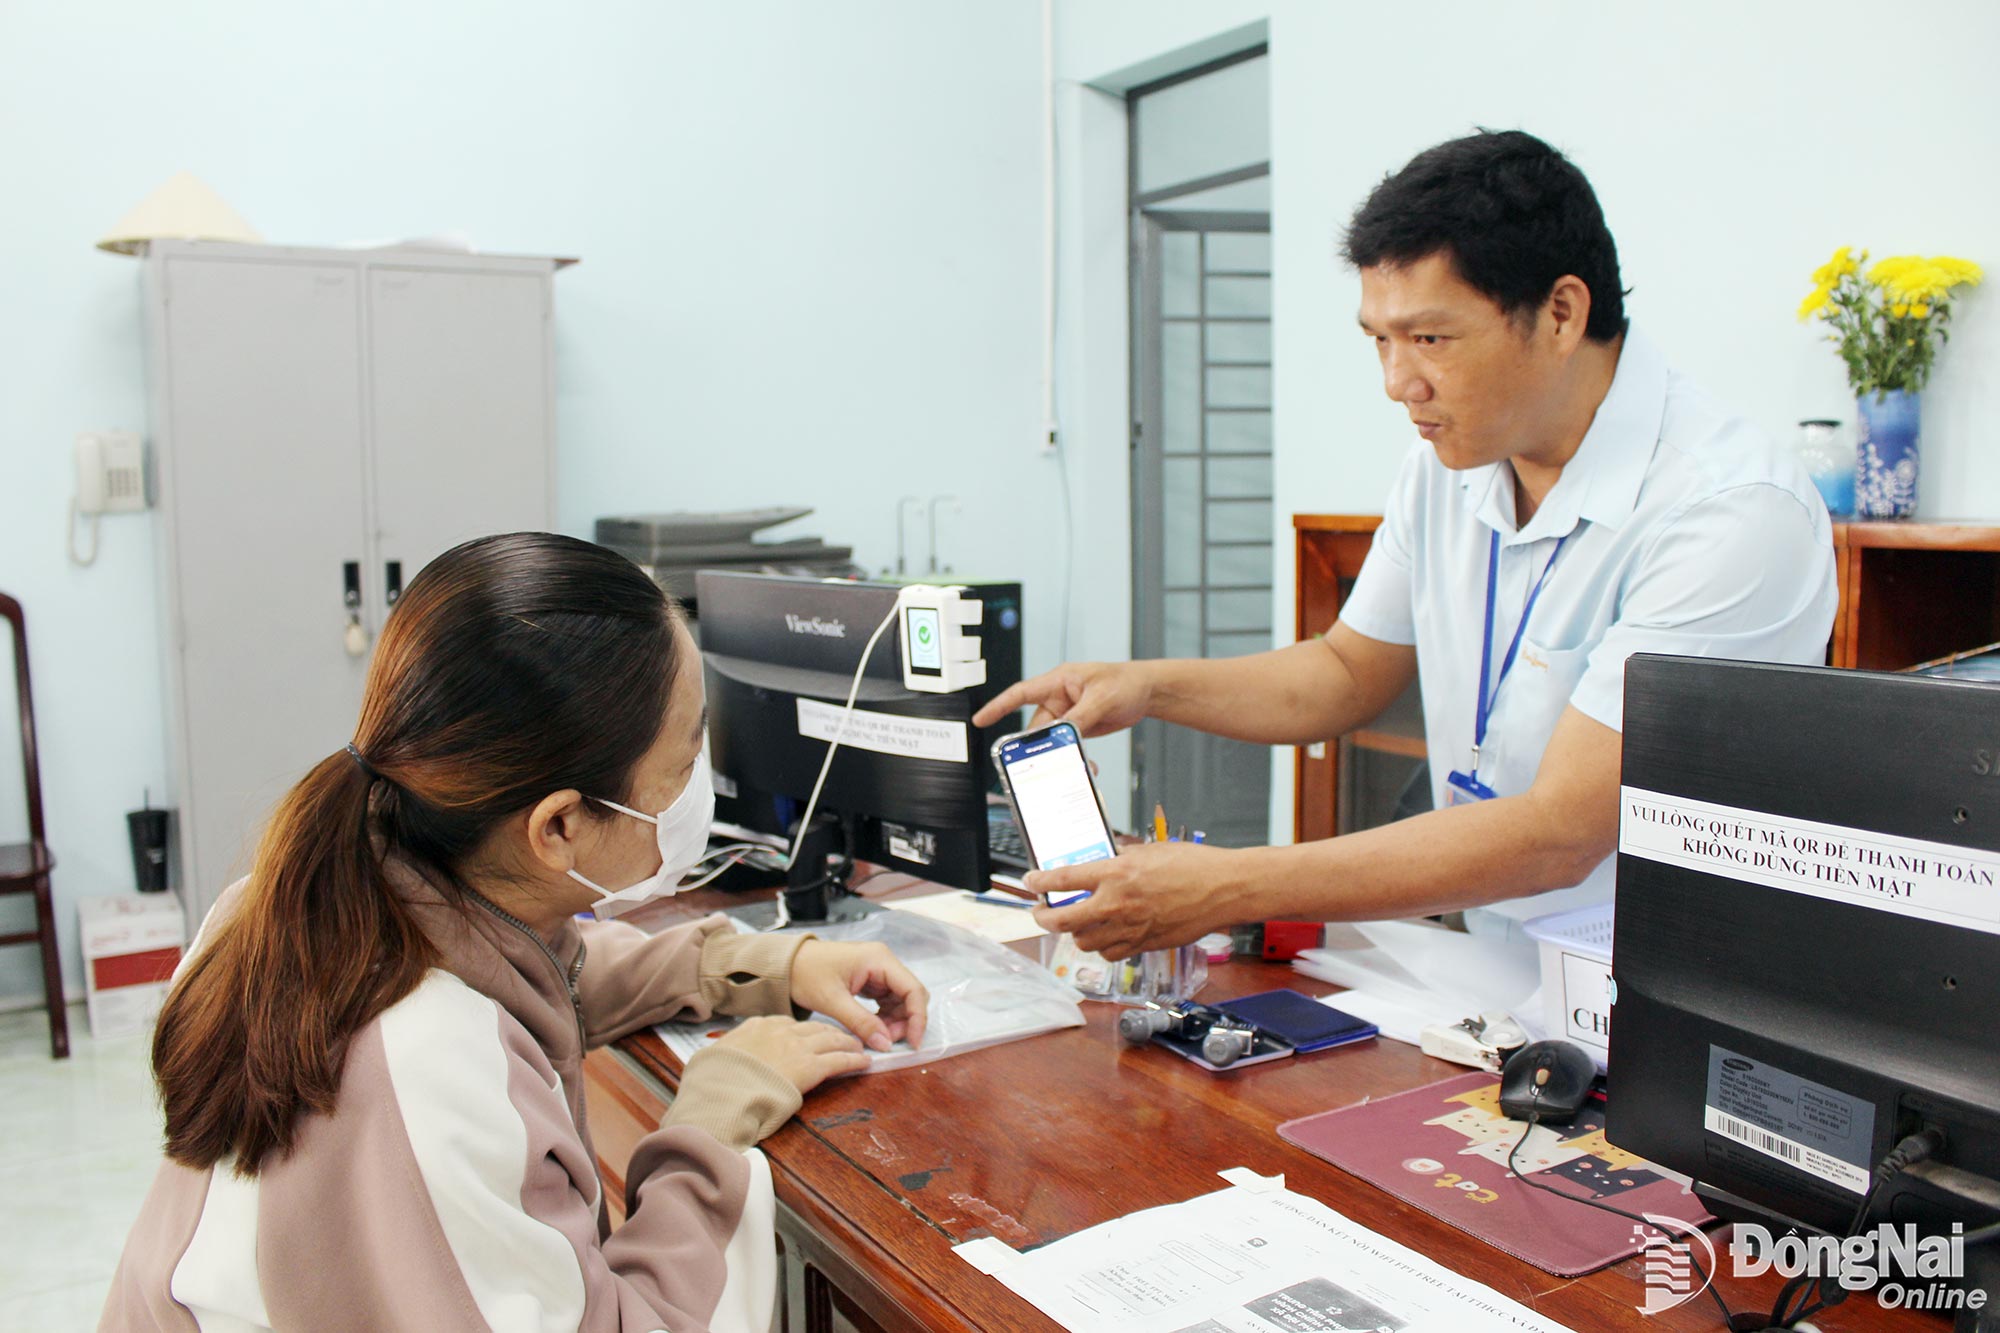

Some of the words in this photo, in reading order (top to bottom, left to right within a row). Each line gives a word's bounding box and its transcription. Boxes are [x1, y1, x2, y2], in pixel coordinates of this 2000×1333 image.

[785, 613, 846, 638] ViewSonic
[1632, 804, 1656, 822] VUI
[1661, 809, 1705, 832] LÒNG
[1709, 821, 1756, 842] QUÉT
[1760, 830, 1788, 849] MÃ
[1793, 836, 1819, 855] QR
[1825, 840, 1849, 860] ĐỂ
[1855, 847, 1926, 875] THANH
[1933, 861, 1994, 887] TOÁN
[1682, 837, 1748, 864] KHÔNG
[1753, 850, 1807, 876] DÙNG
[1812, 863, 1860, 887] TIỀN
[1867, 874, 1916, 898] MẶT
[1278, 1293, 1307, 1309] TRUNG
